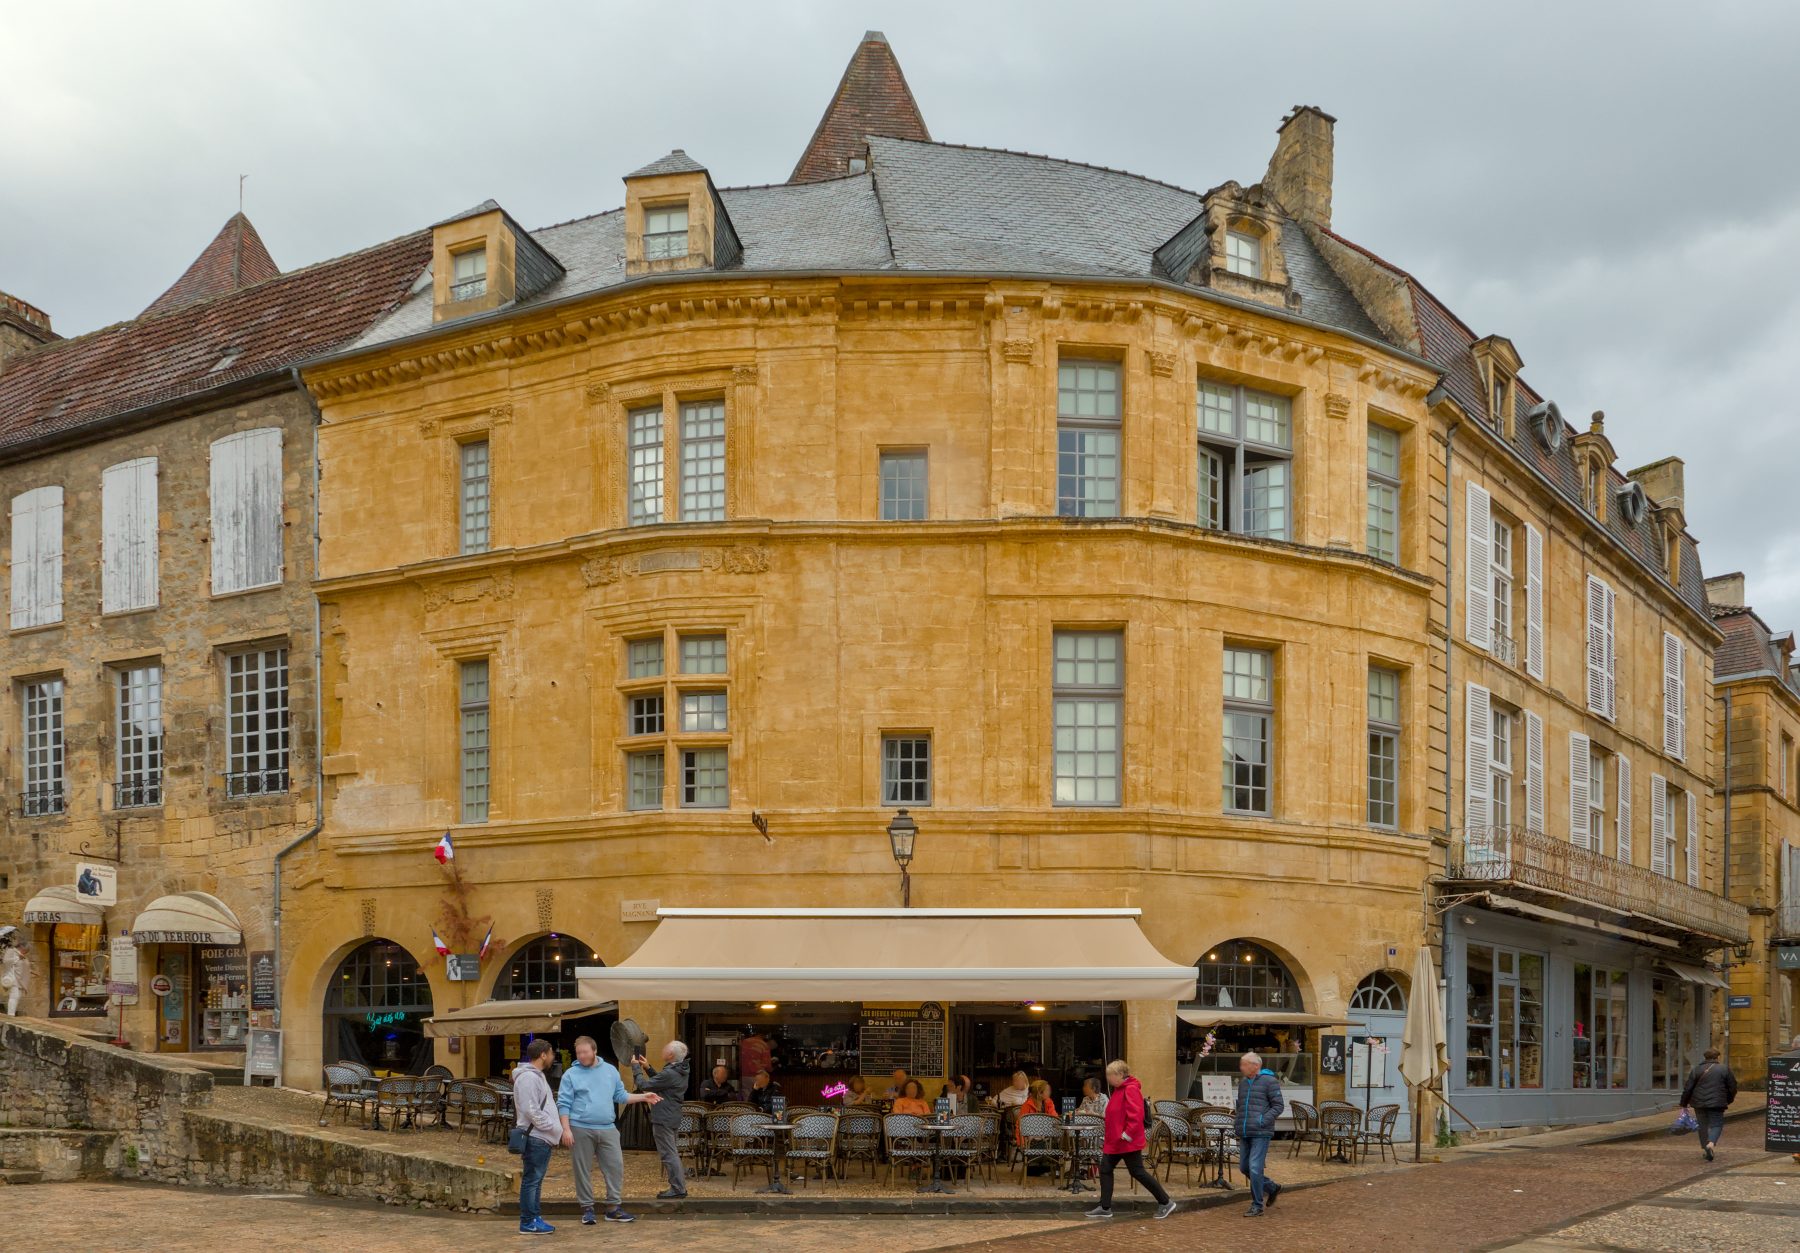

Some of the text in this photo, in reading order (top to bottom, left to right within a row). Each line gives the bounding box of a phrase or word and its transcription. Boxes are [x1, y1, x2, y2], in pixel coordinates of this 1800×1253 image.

[37, 912, 62, 922] GRAS
[163, 931, 213, 943] TERROIR
[201, 949, 225, 960] FOIE
[205, 964, 223, 972] Vente
